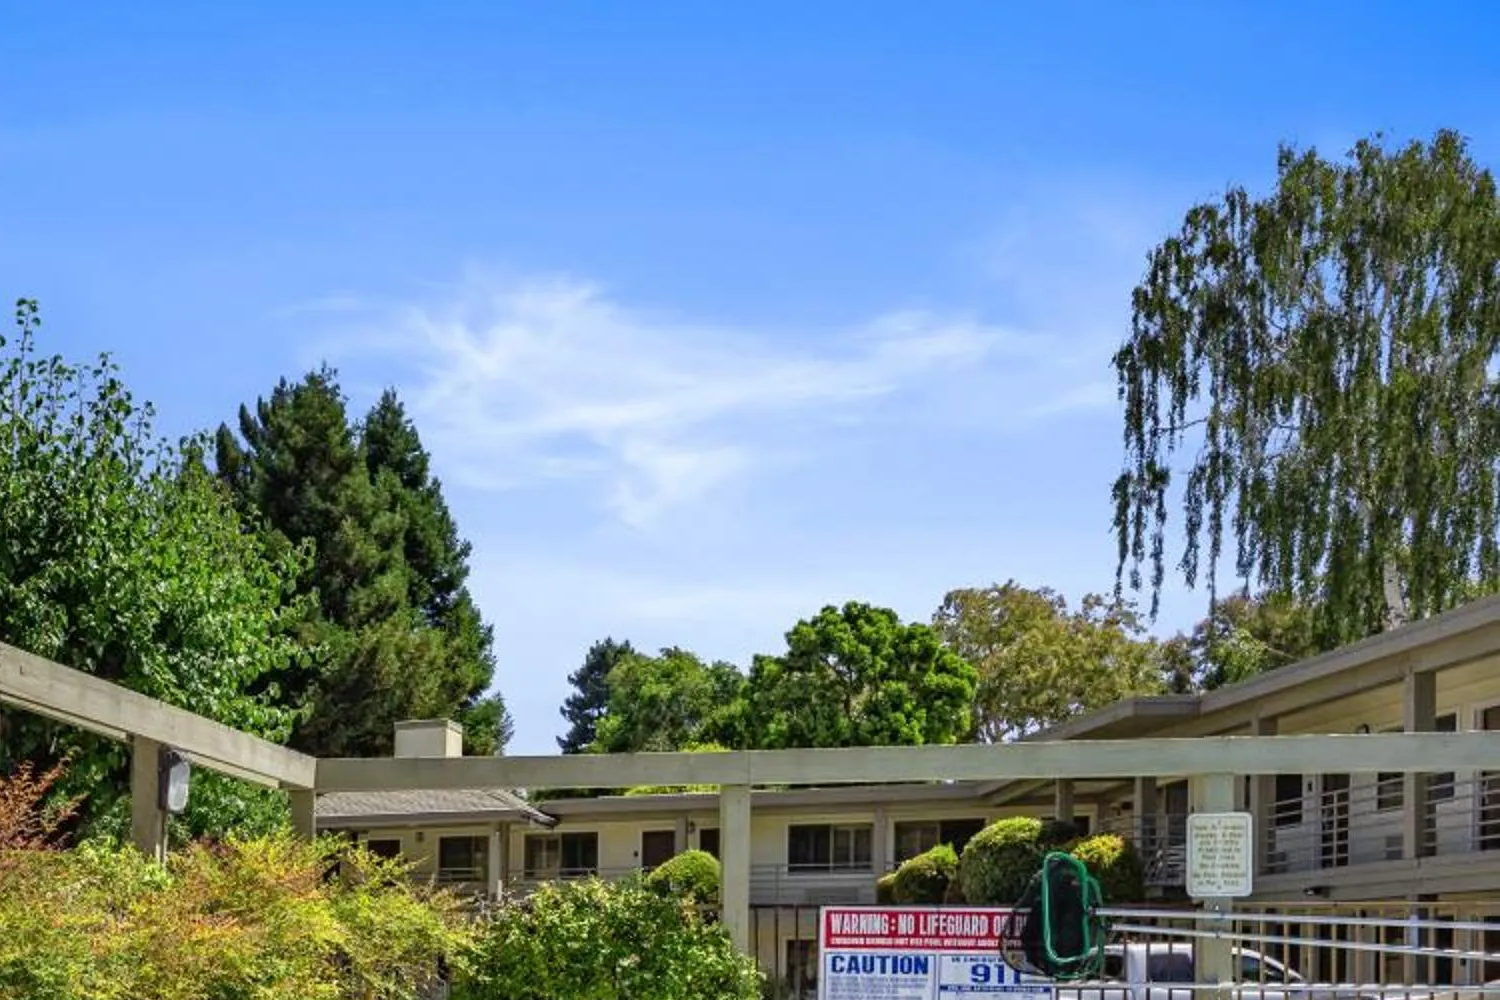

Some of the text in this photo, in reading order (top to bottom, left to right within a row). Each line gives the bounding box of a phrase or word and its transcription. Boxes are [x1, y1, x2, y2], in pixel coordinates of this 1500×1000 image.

[831, 913, 896, 935] WARNING:
[898, 914, 915, 935] NO
[919, 914, 988, 937] LIFEGUARD
[831, 955, 928, 974] CAUTION
